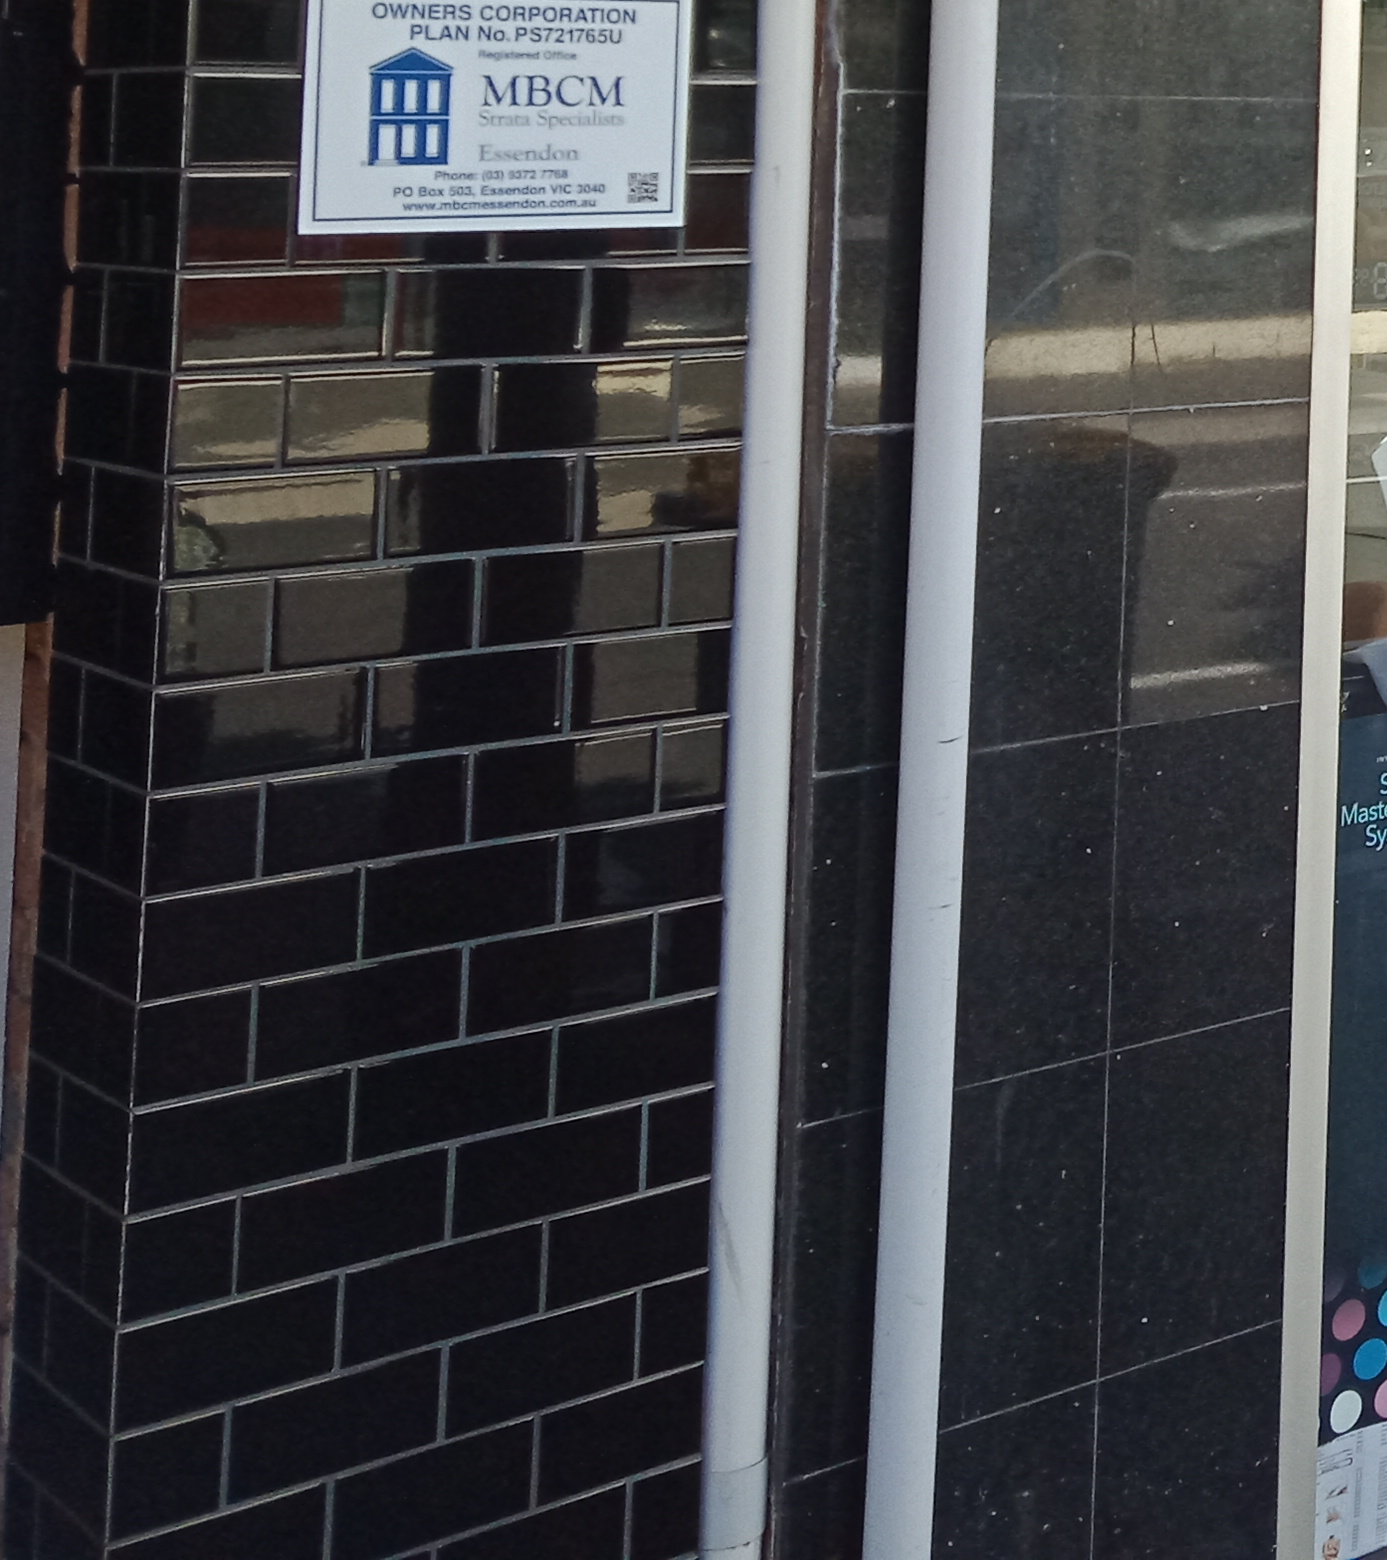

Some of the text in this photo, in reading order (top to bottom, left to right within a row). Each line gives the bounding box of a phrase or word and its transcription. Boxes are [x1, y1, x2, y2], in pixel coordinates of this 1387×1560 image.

[372, 2, 637, 24] OWNERS CORPORATION
[410, 24, 622, 44] PLAN No. PS721765U
[478, 49, 577, 62] Registered Office
[481, 74, 625, 107] MBCM
[478, 111, 625, 130] Strata Specialists
[478, 143, 579, 162] Essendon
[434, 170, 478, 182] Phone:
[392, 186, 414, 198] PO
[417, 186, 445, 198] Box
[480, 184, 547, 197] Essendon
[551, 183, 572, 195] VIC
[576, 183, 606, 195] 3040
